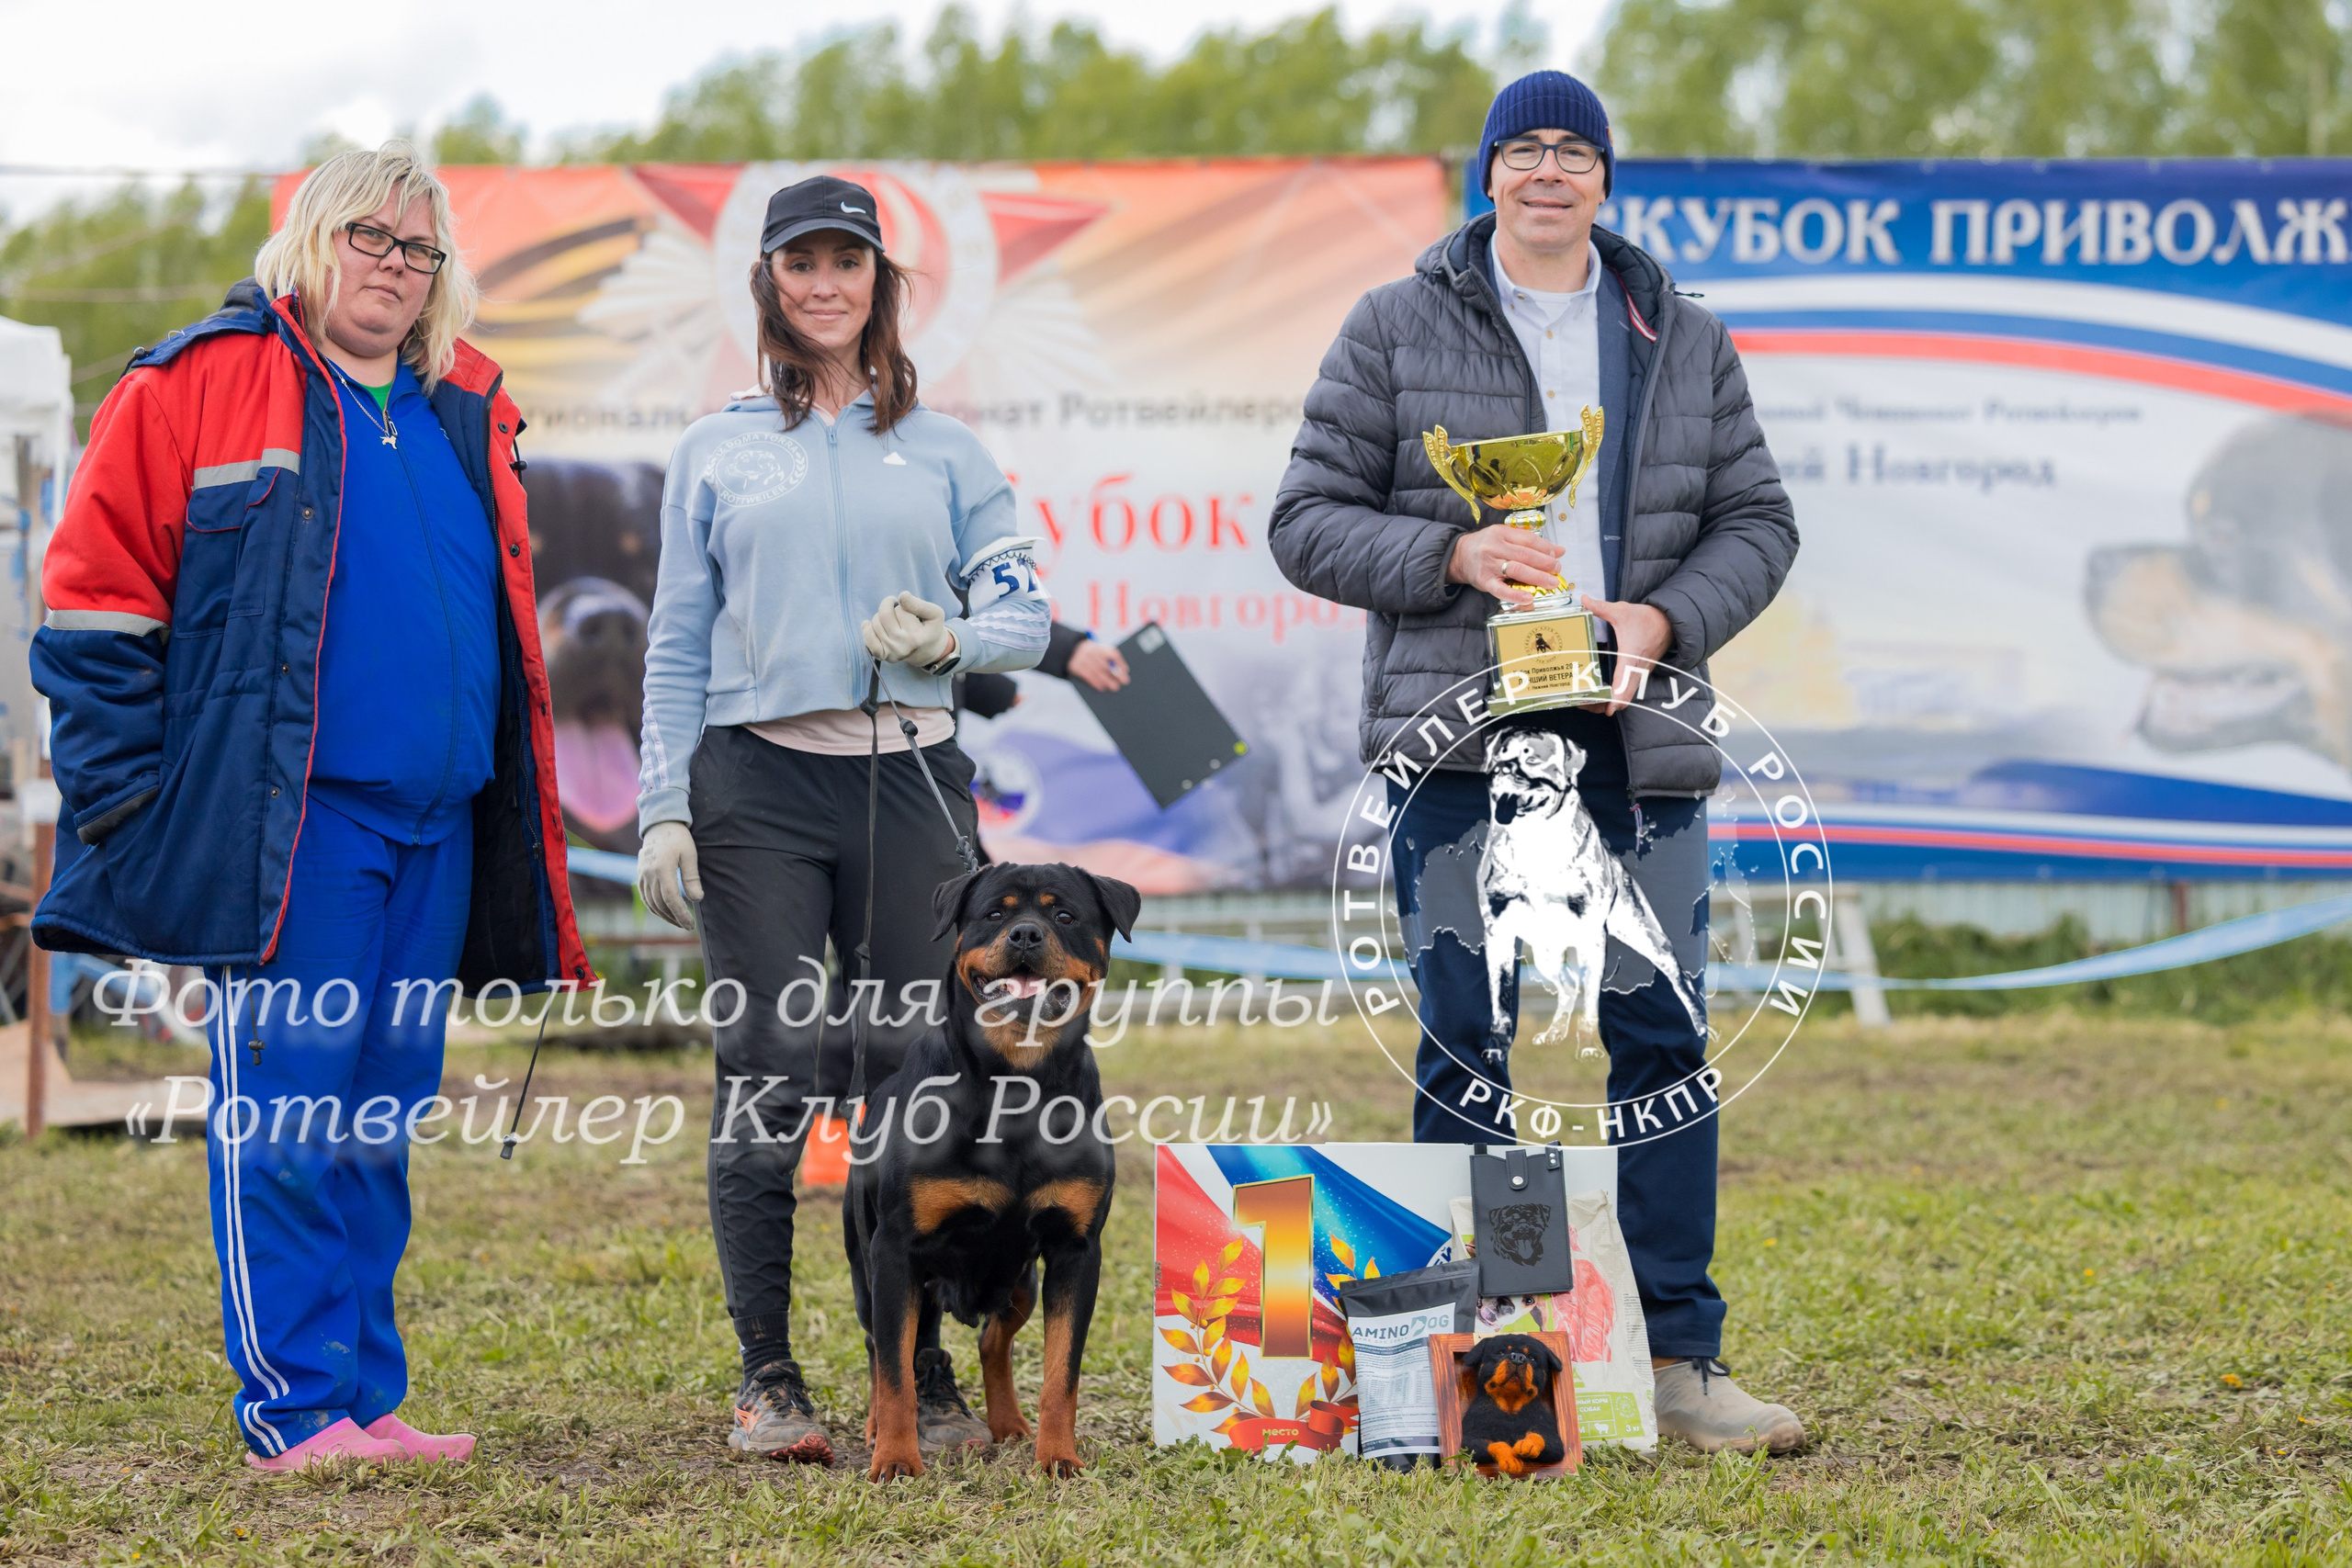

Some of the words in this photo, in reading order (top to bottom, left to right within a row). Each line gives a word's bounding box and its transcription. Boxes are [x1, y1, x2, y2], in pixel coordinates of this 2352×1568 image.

[1930, 196, 2352, 266] ПРИВОЛЖ
[1058, 394, 1306, 434] Ротвейлеро
[726, 434, 760, 447] DOMA
[763, 434, 798, 453] TORRA
[719, 484, 787, 504] ROTTWEILER
[1004, 471, 1255, 579] убок
[1548, 671, 1575, 682] ВЕТЕРА
[1233, 1174, 1314, 1359] 1
